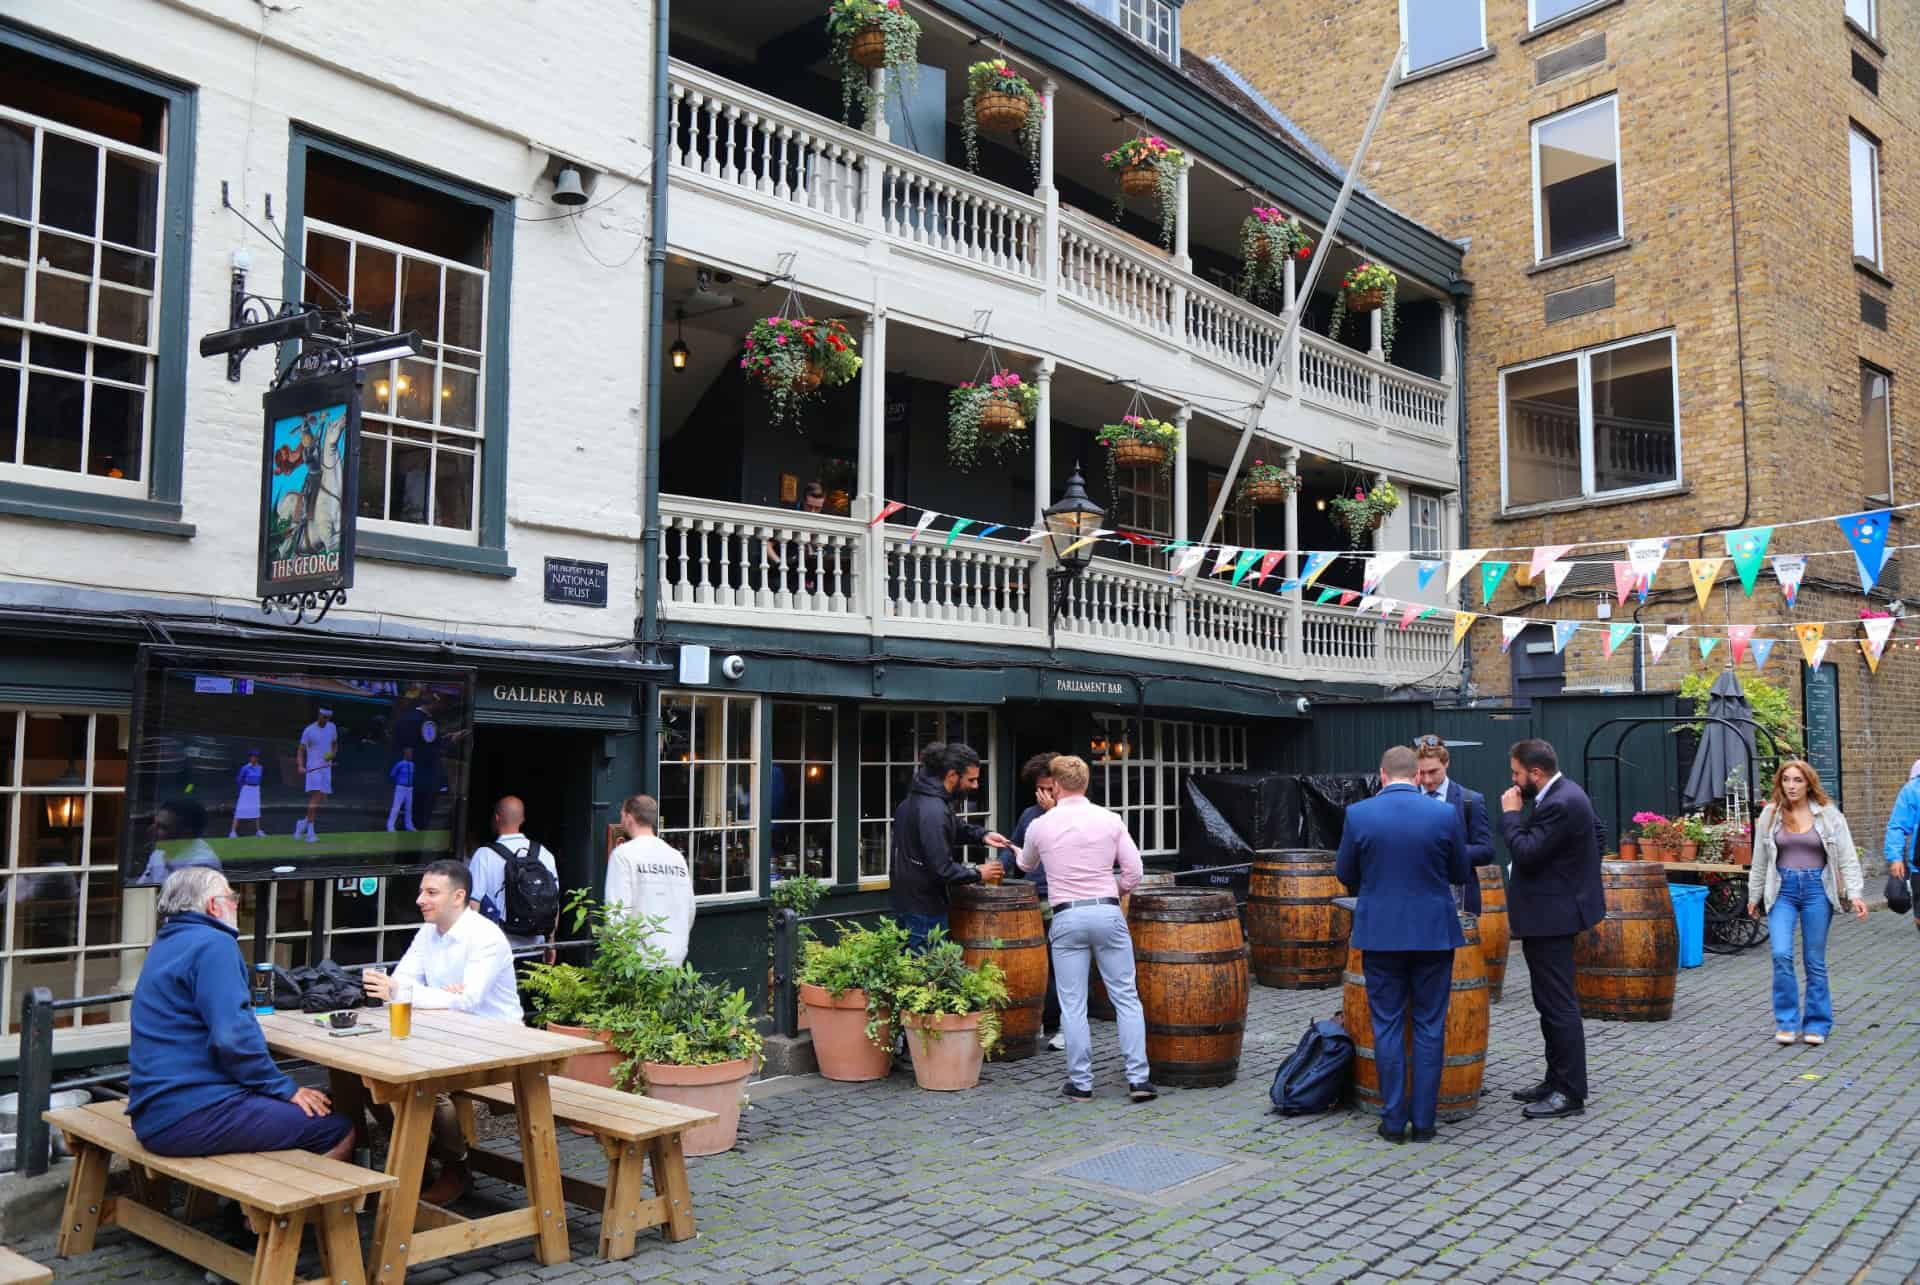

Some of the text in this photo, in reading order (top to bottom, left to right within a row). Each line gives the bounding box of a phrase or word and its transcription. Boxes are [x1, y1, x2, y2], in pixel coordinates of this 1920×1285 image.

[272, 560, 292, 577] THE
[548, 563, 559, 571] THE
[560, 565, 587, 574] PROPERTY
[552, 573, 601, 588] NATIONAL
[563, 586, 590, 599] TRUST
[1056, 679, 1123, 694] PARLIAMENT BAR
[493, 684, 605, 707] GALLERY BAR
[636, 863, 687, 878] ALLSAINTS
